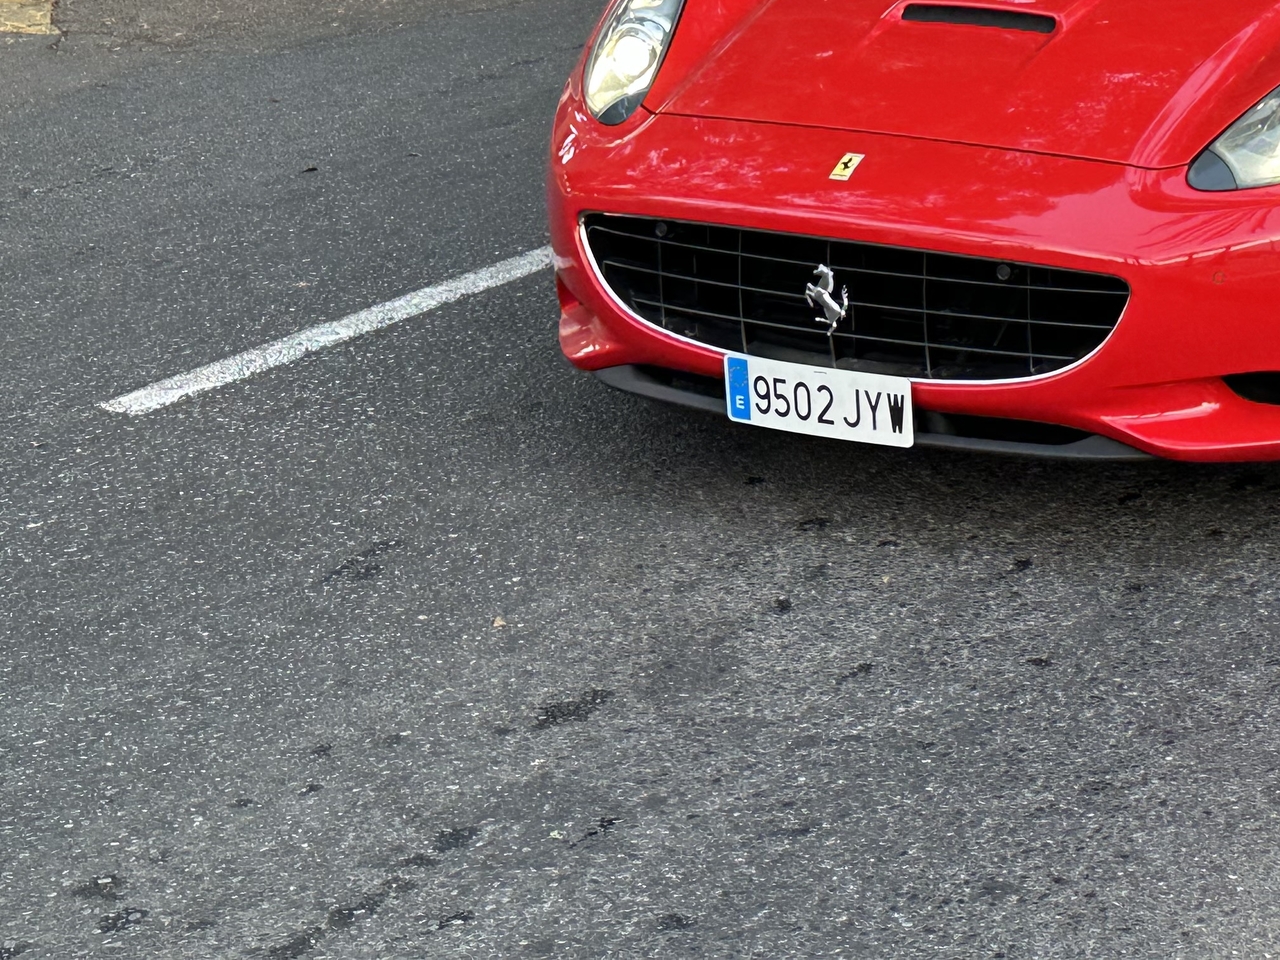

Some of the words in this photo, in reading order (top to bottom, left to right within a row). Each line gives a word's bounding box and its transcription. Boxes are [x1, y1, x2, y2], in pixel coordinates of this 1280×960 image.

[736, 395, 745, 409] E
[753, 375, 835, 426] 9502
[844, 389, 905, 435] JYW
